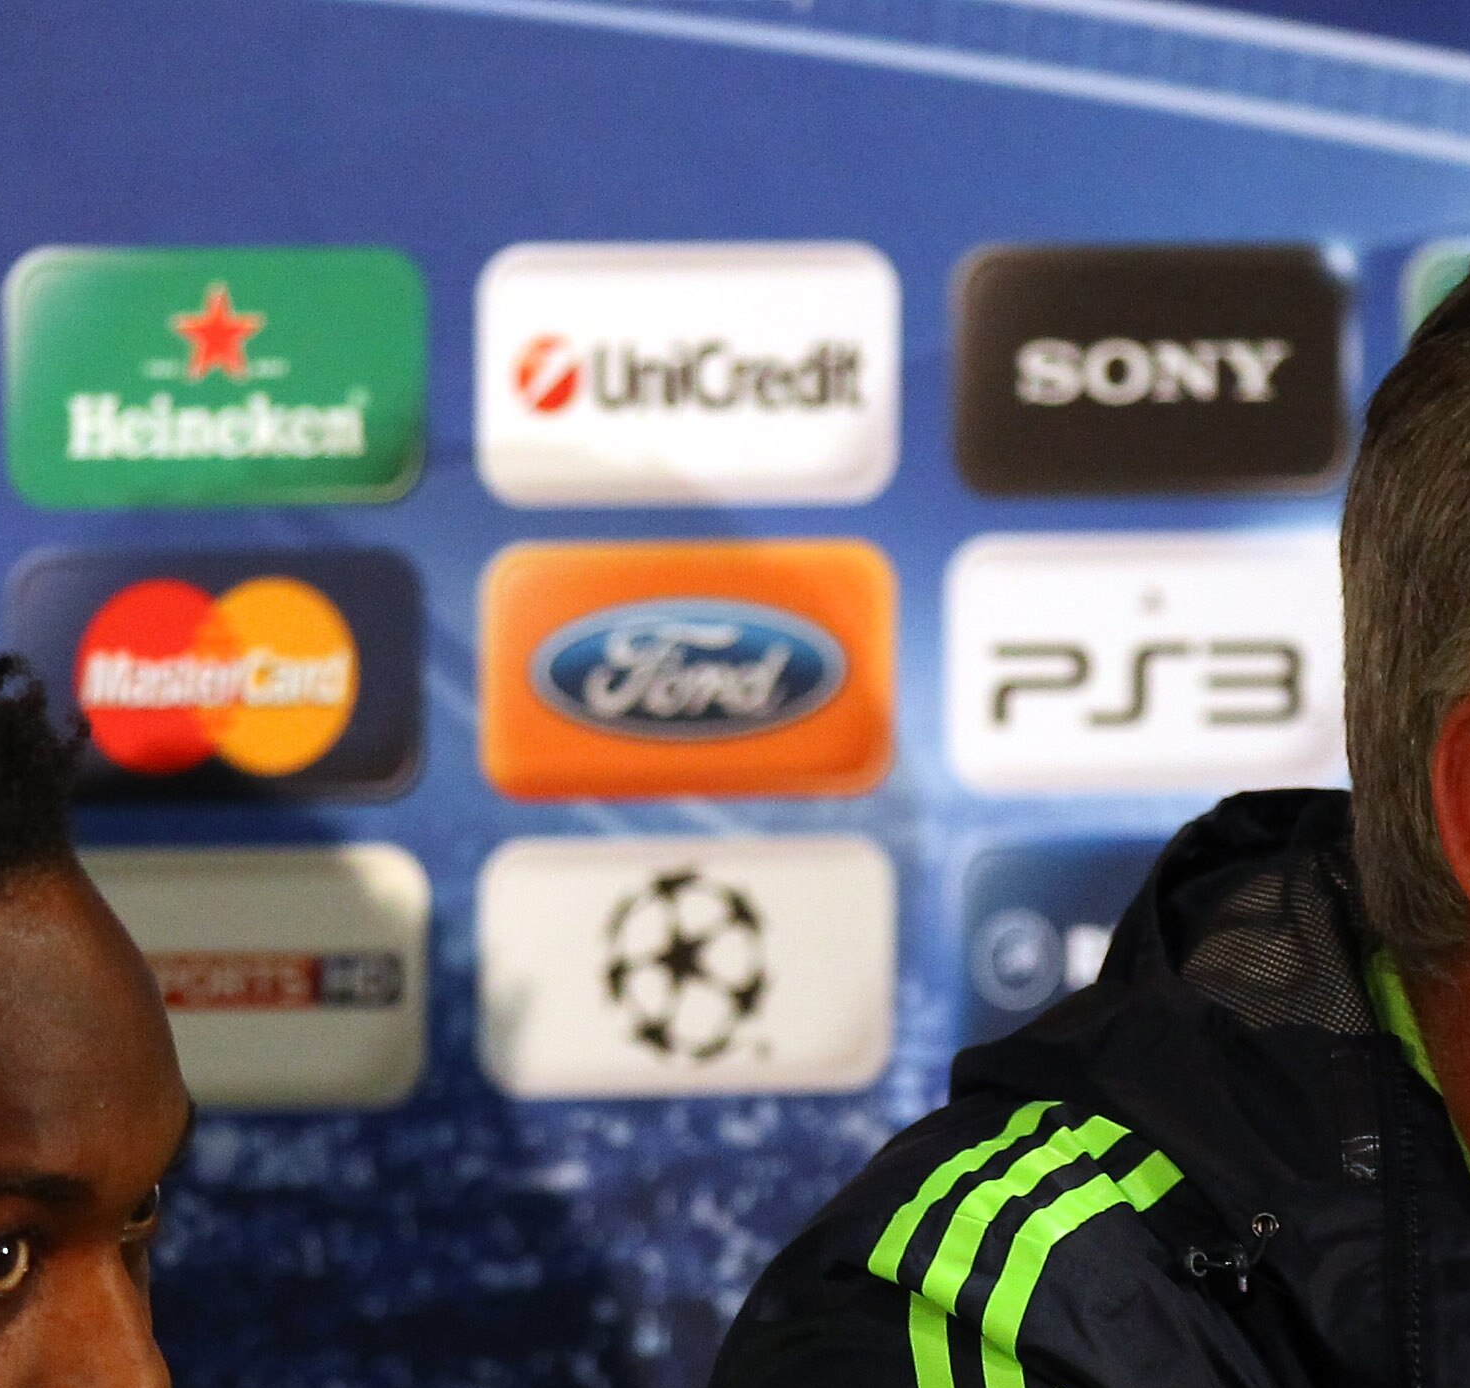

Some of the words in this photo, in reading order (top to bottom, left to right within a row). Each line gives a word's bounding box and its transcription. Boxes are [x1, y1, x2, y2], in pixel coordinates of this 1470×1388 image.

[593, 340, 863, 411] UniCredit
[1015, 338, 1291, 408] SONY
[67, 392, 361, 460] Heineken
[81, 650, 351, 708] MasterCard
[583, 618, 789, 718] Ford
[986, 642, 1305, 726] PS3
